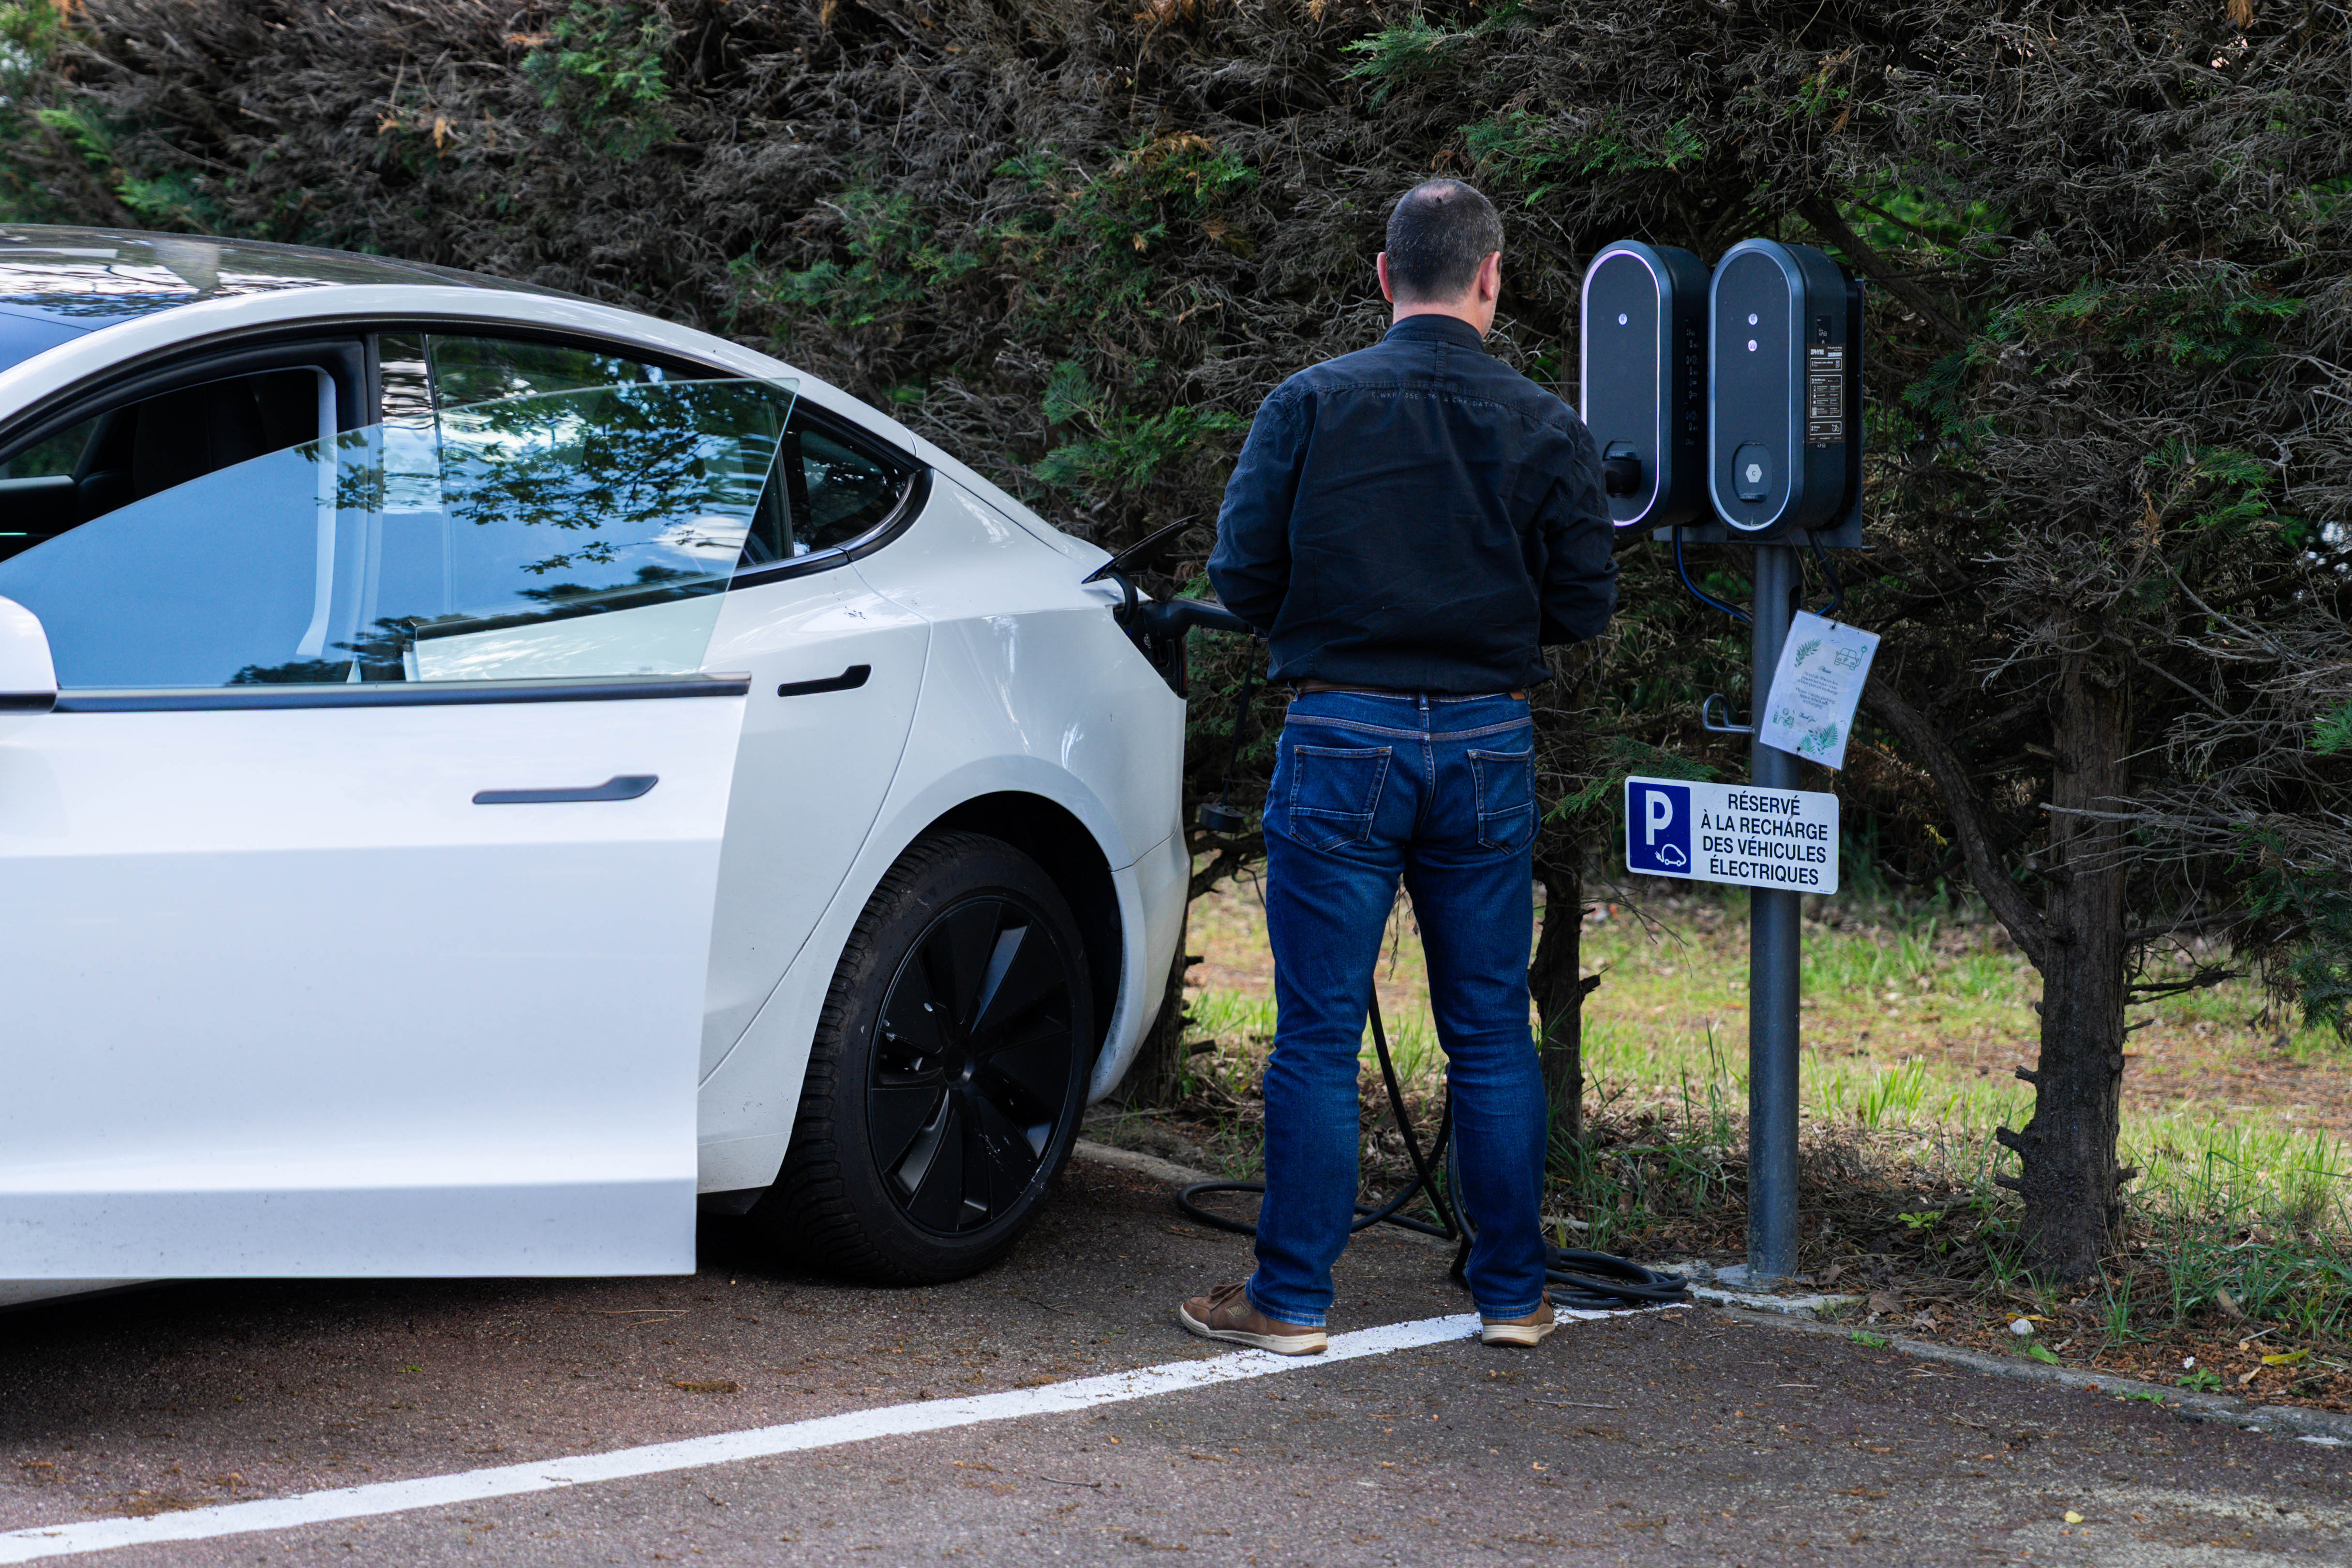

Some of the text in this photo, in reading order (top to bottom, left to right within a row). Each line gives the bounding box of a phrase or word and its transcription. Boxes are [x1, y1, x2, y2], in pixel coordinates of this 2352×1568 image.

[1645, 790, 1673, 845] P
[1728, 791, 1800, 816] RÉSERVÉ
[1701, 809, 1828, 841] À LA RECHARGE
[1703, 836, 1826, 863] DES VÉHICULES
[1711, 854, 1818, 885] ÉLECTRIQUES
